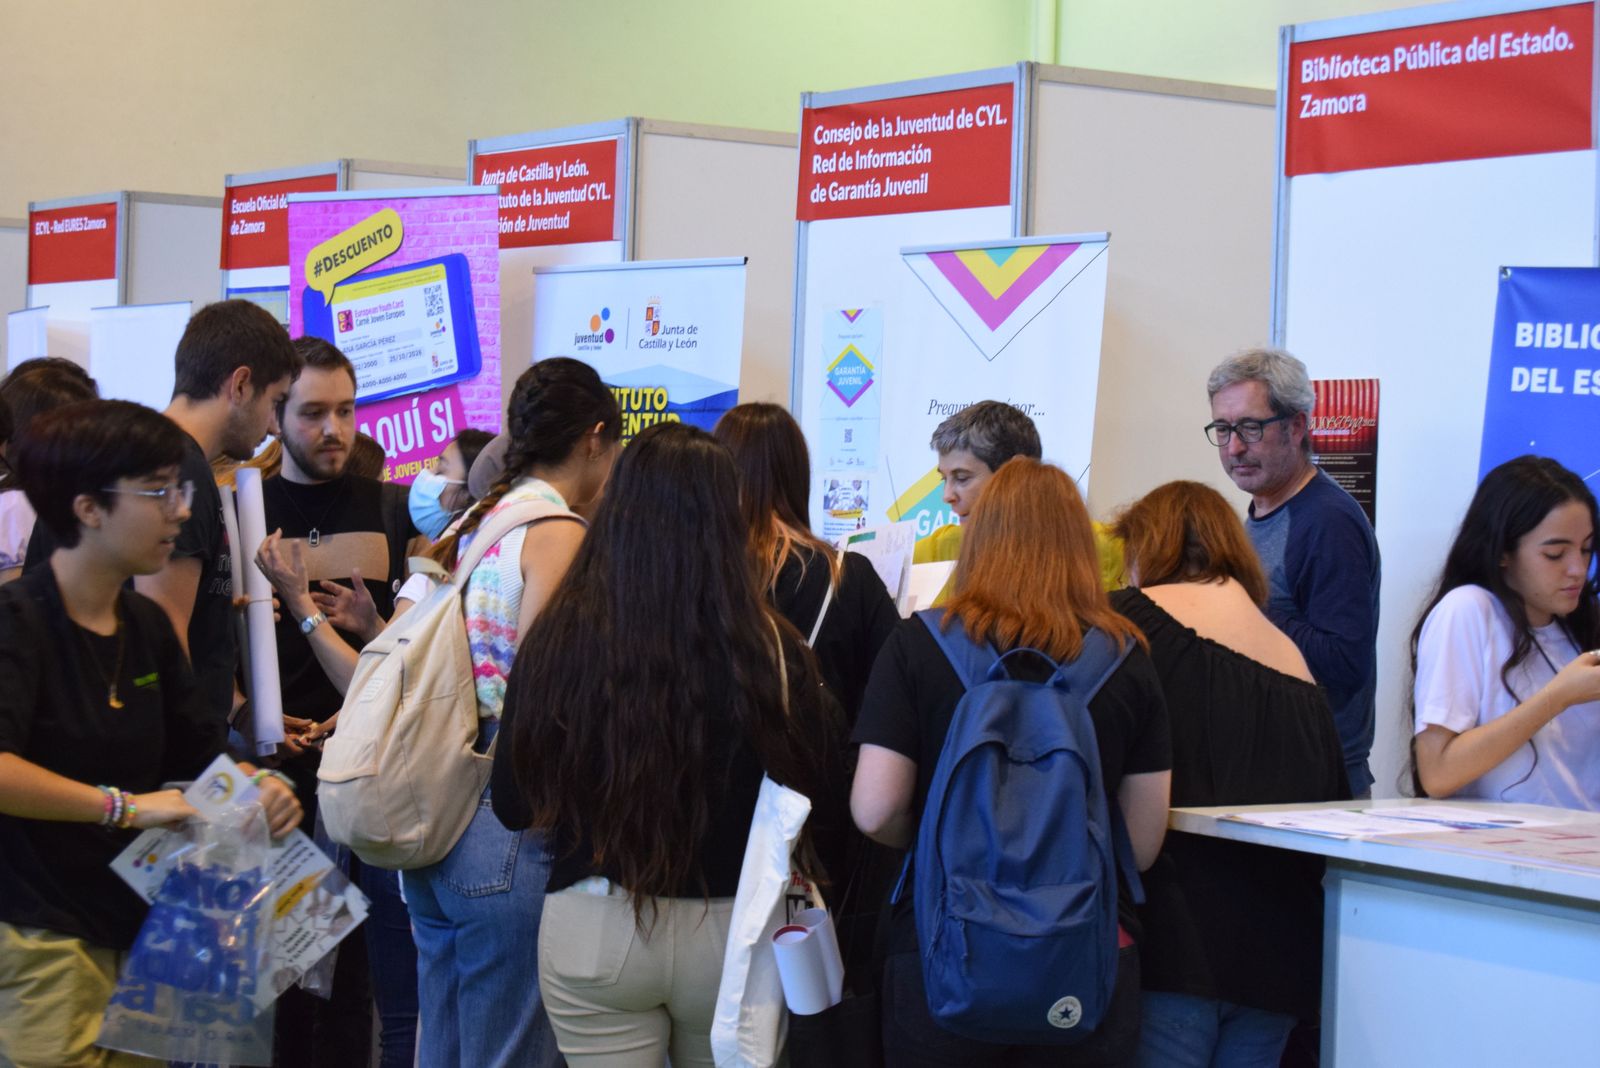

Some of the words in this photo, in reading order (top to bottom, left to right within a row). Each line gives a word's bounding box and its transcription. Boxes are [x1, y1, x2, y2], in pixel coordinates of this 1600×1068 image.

[1301, 53, 1391, 84] Biblioteca
[1394, 40, 1462, 72] Pública
[1465, 34, 1495, 63] del
[1499, 25, 1574, 59] Estado.
[1299, 92, 1367, 119] Zamora
[813, 120, 862, 146] Consejo
[863, 119, 879, 140] de
[881, 116, 893, 139] la
[894, 110, 954, 137] Juventud
[956, 106, 973, 129] de
[975, 103, 1008, 127] CYL.
[812, 152, 836, 174] Red
[838, 151, 853, 172] de
[855, 143, 932, 170] Información
[481, 169, 505, 186] Junta
[506, 166, 518, 184] de
[519, 162, 554, 183] Castilla
[555, 165, 562, 182] y
[563, 159, 590, 179] León.
[519, 189, 532, 208] de
[533, 188, 542, 206] la
[543, 184, 587, 206] Juventud
[588, 182, 611, 201] CYL.
[810, 183, 827, 204] de
[828, 177, 881, 202] Garantía
[882, 172, 929, 197] Juvenil
[231, 198, 257, 214] Escuela
[256, 194, 279, 211] Oficial
[35, 221, 50, 235] ECYL
[53, 220, 64, 233] Red
[64, 217, 83, 232] EURES
[84, 216, 107, 231] Zamora
[231, 220, 240, 235] de
[240, 219, 265, 234] Zamora
[514, 214, 526, 232] de
[527, 211, 570, 232] Juventud
[313, 223, 393, 278] #DESCUENTO
[574, 332, 604, 346] juventud
[661, 325, 685, 336] Junta
[686, 325, 698, 335] de
[638, 338, 667, 350] Castilla
[668, 340, 674, 352] y
[675, 337, 698, 349] León
[1511, 366, 1564, 394] DEL
[429, 397, 455, 443] SI
[394, 460, 422, 480] JOVEN
